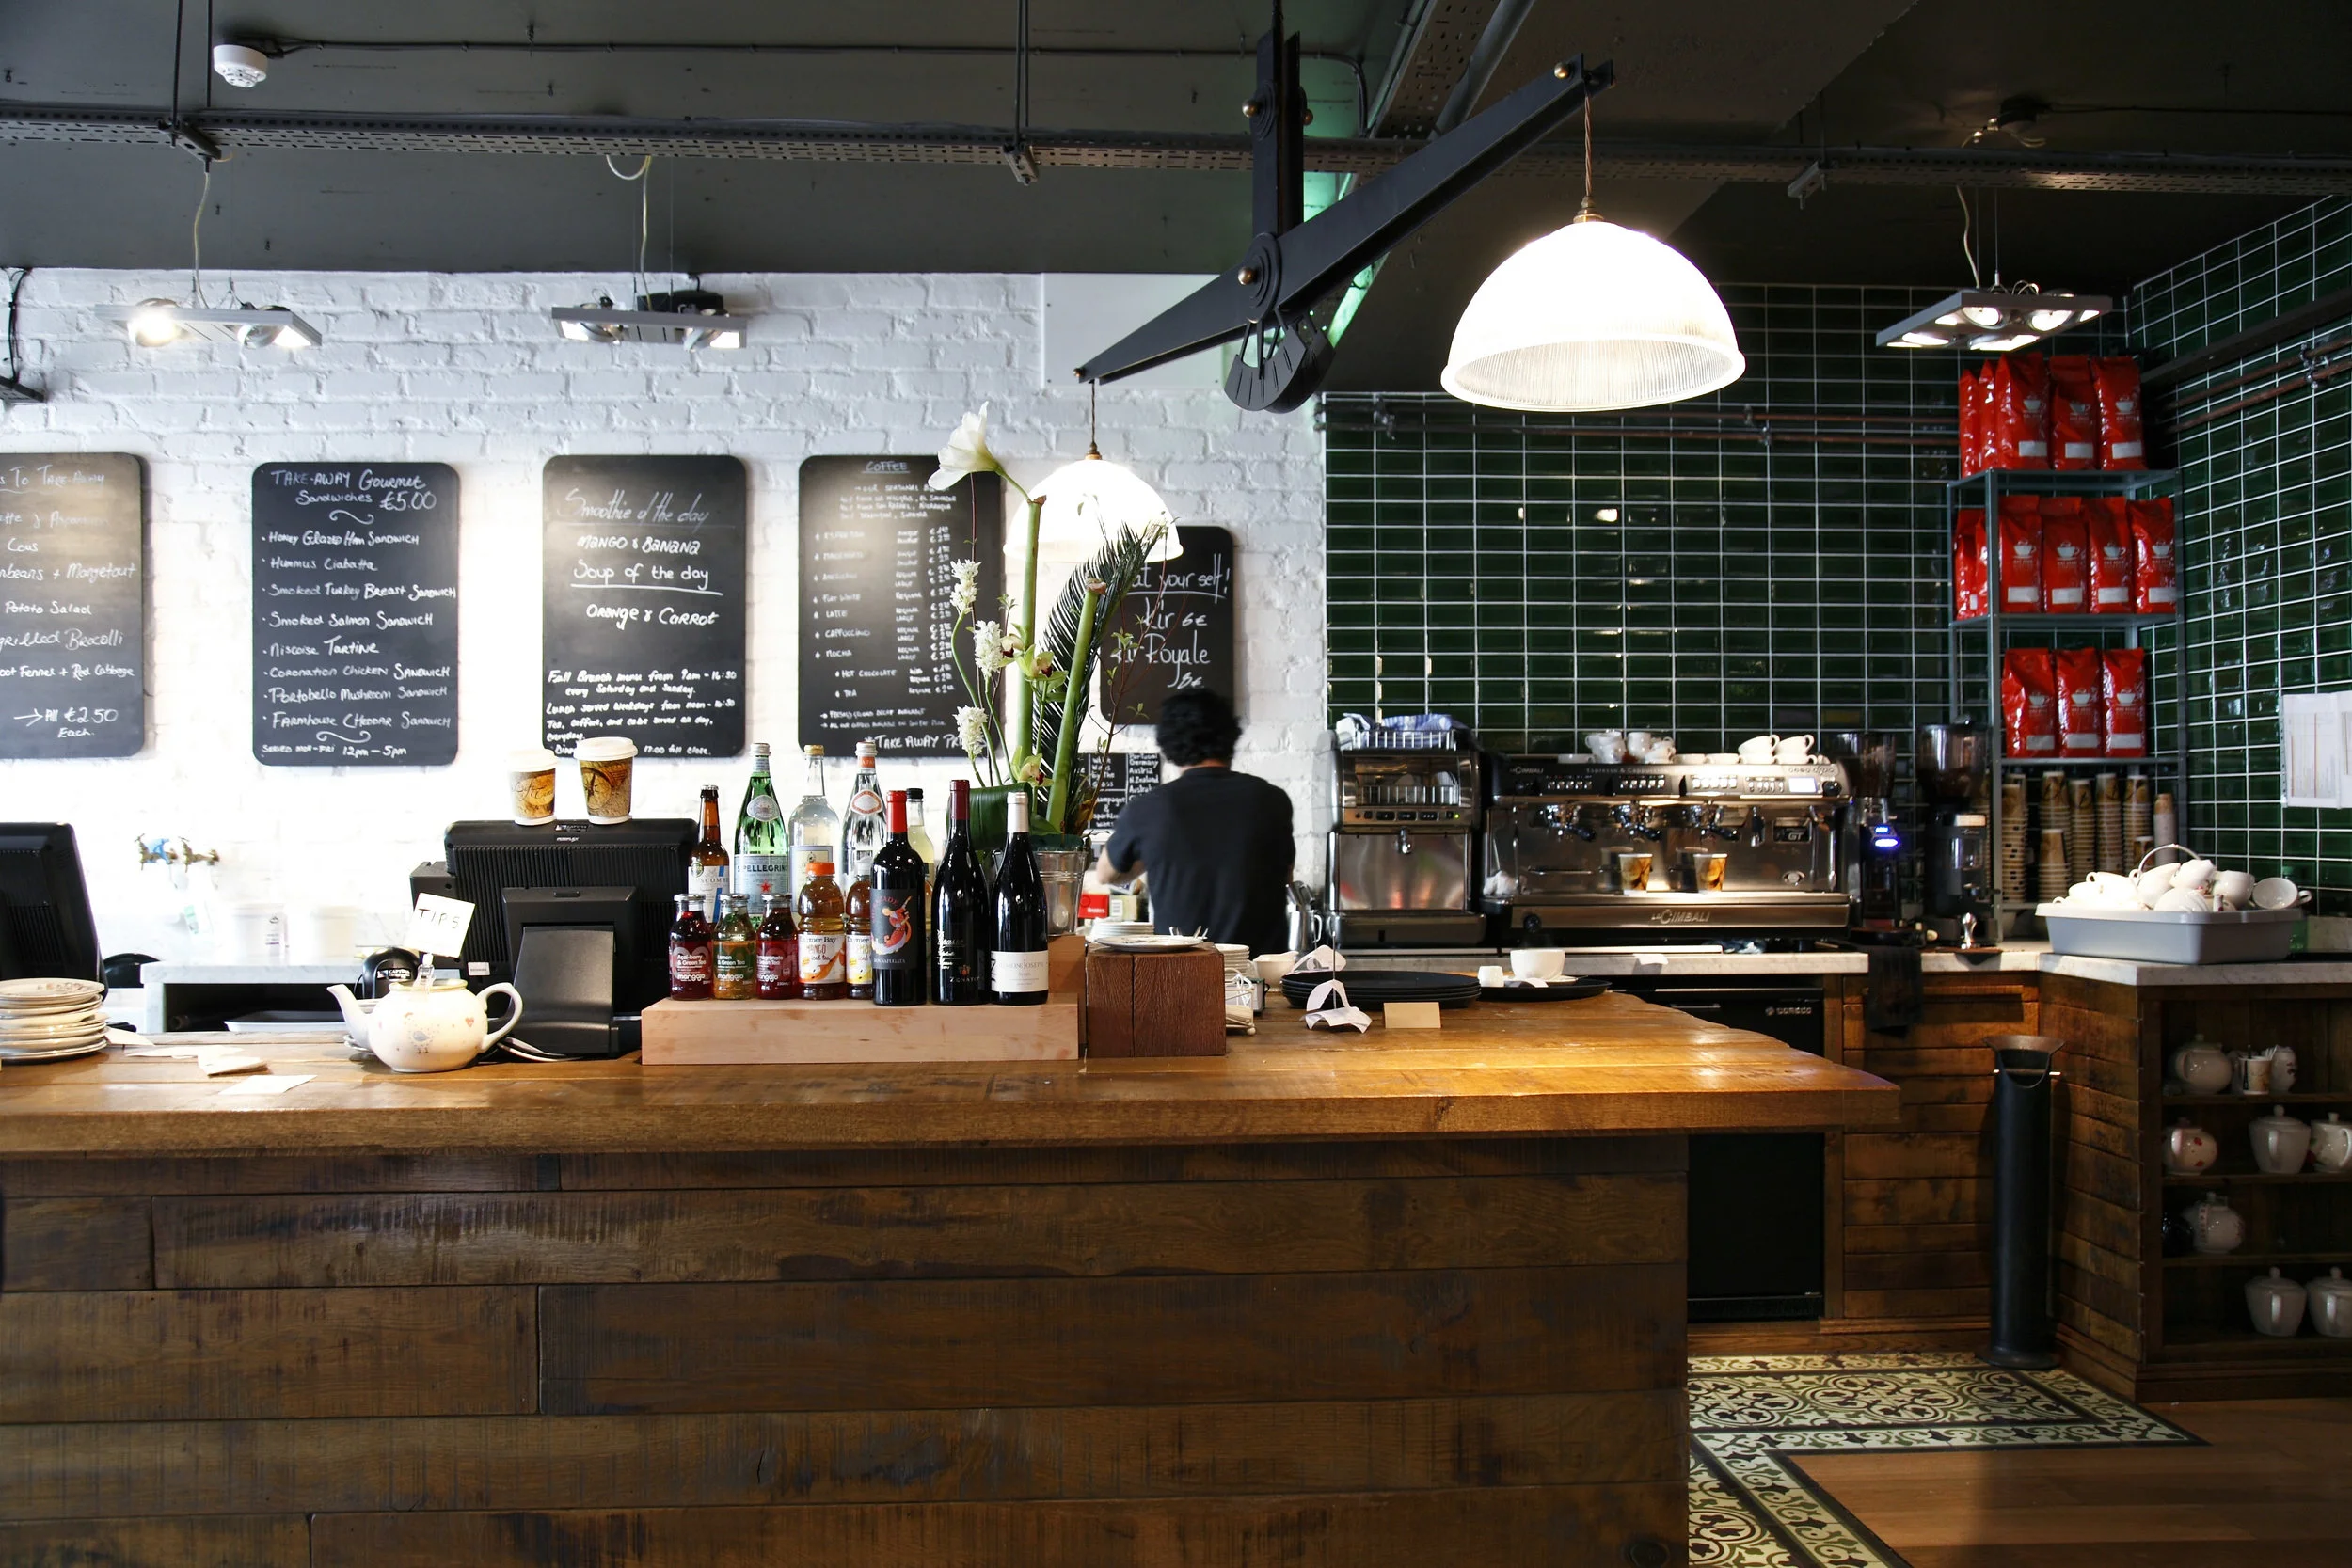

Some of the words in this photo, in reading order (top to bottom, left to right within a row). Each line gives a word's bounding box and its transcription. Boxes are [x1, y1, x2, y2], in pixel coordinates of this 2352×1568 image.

[9, 466, 29, 487] To
[358, 469, 426, 491] Gourmet
[295, 490, 373, 505] Sandwiches
[379, 491, 437, 511] €5.00
[556, 488, 632, 520] Smoothie
[7, 538, 39, 552] Cous
[574, 558, 614, 585] Soup
[624, 563, 644, 583] of
[652, 565, 674, 579] the
[680, 565, 709, 591] day
[1159, 573, 1195, 597] your
[5, 600, 44, 614] Potato
[50, 600, 92, 615] Salad
[268, 610, 324, 628] Smoked
[328, 613, 370, 627] Salmon
[1144, 629, 1211, 688] Royale
[72, 663, 91, 681] Red
[94, 664, 135, 677] Cabbage
[648, 670, 674, 682] from
[681, 668, 701, 680] 9am
[639, 685, 657, 693] and
[546, 702, 575, 714] Lunch
[383, 745, 407, 757] 5pm
[875, 735, 901, 749] TAKE
[905, 735, 939, 749] AWAY
[1788, 832, 1804, 841] GT
[419, 908, 460, 928] TIPS
